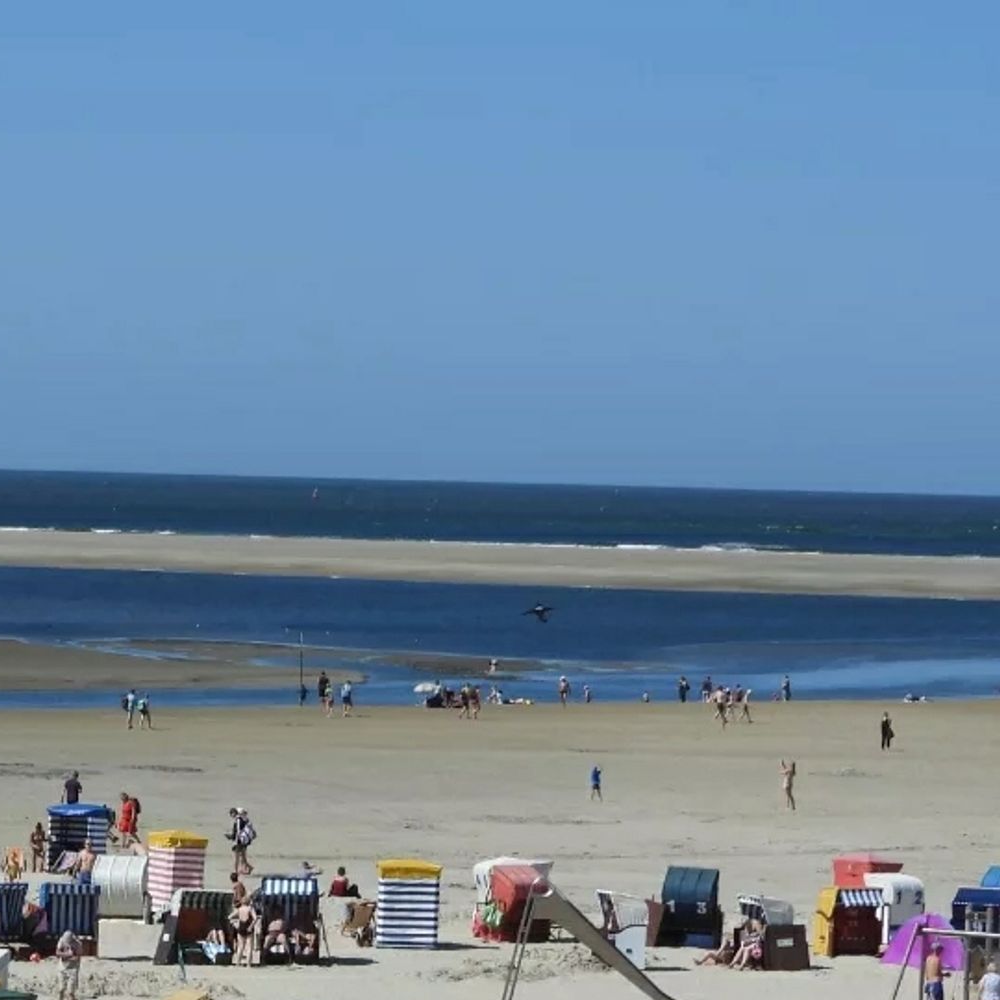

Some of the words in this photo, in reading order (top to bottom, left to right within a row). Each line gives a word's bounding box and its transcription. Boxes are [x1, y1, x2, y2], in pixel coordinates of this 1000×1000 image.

[895, 889, 903, 905] 1
[666, 899, 676, 913] 1
[696, 901, 707, 914] 3
